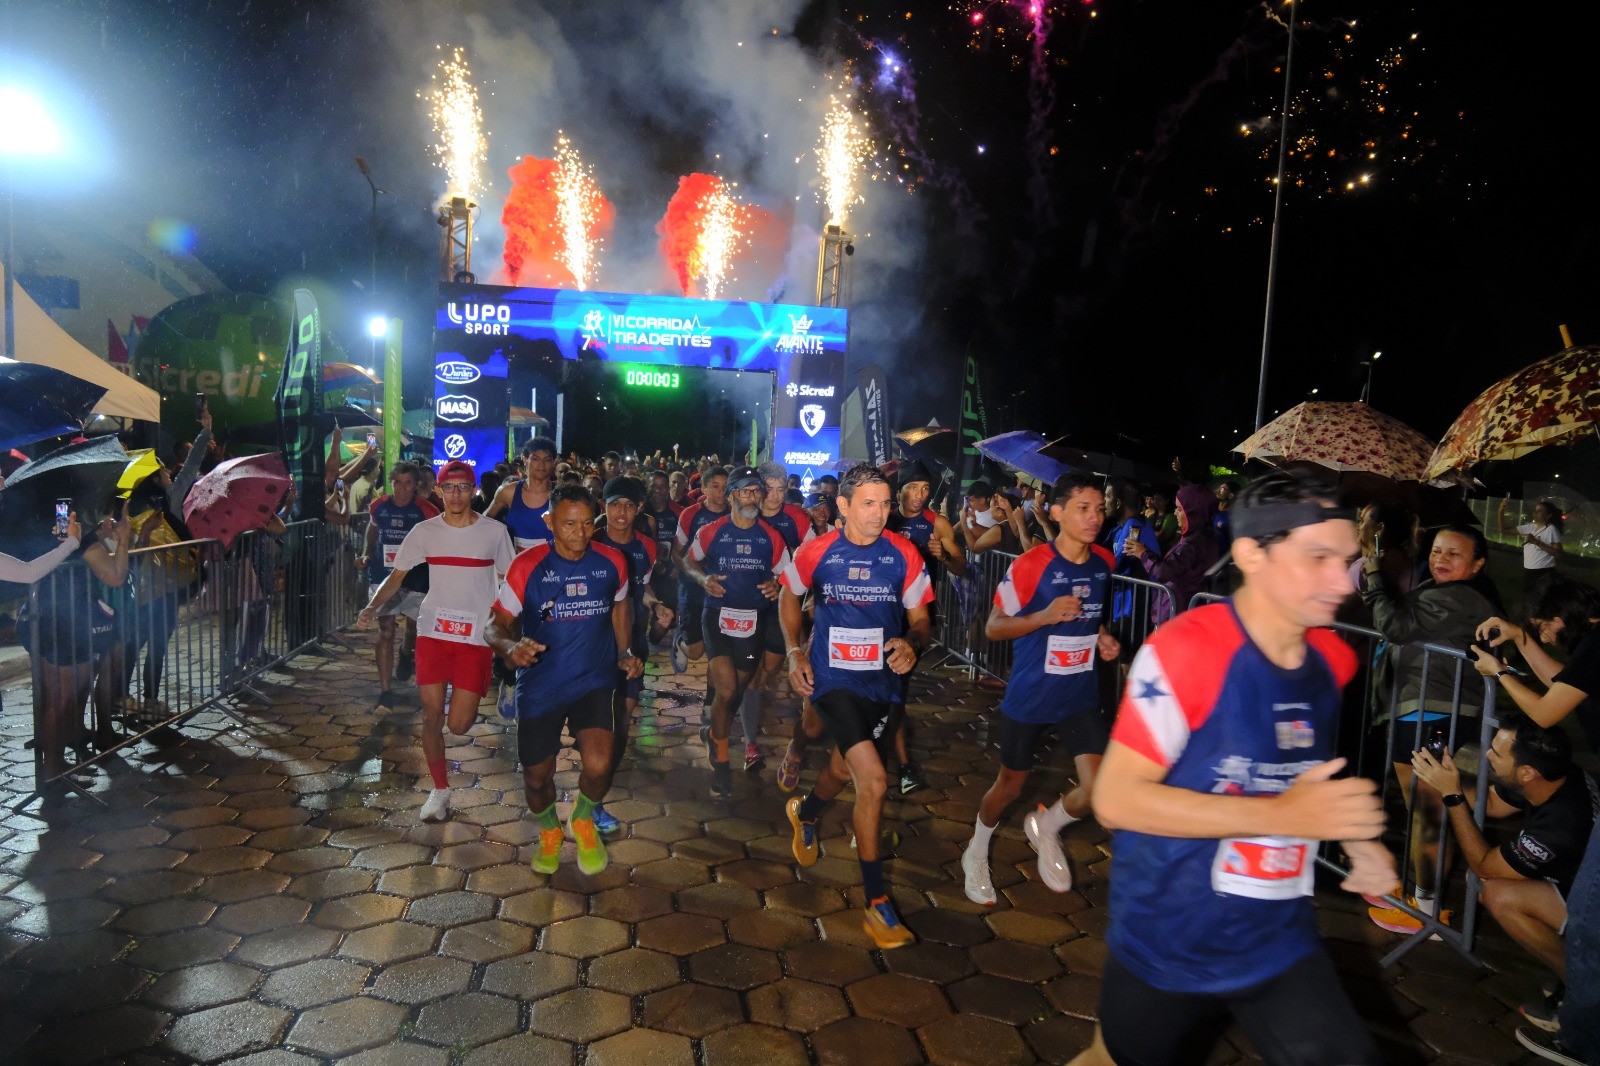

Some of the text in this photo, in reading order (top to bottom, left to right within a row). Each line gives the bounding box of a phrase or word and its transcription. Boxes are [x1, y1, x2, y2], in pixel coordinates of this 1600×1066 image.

[448, 303, 510, 324] LUPO
[465, 322, 510, 336] SPORT
[613, 315, 693, 331] VI CORRIDA
[613, 331, 712, 348] TIRADENTES
[776, 334, 824, 350] AVANTE
[799, 384, 835, 397] Sicredi
[440, 402, 474, 415] MASA
[565, 600, 604, 609] CORRIDA
[839, 594, 897, 602] TIRADENTES
[449, 622, 466, 632] 394
[849, 645, 872, 658] 607
